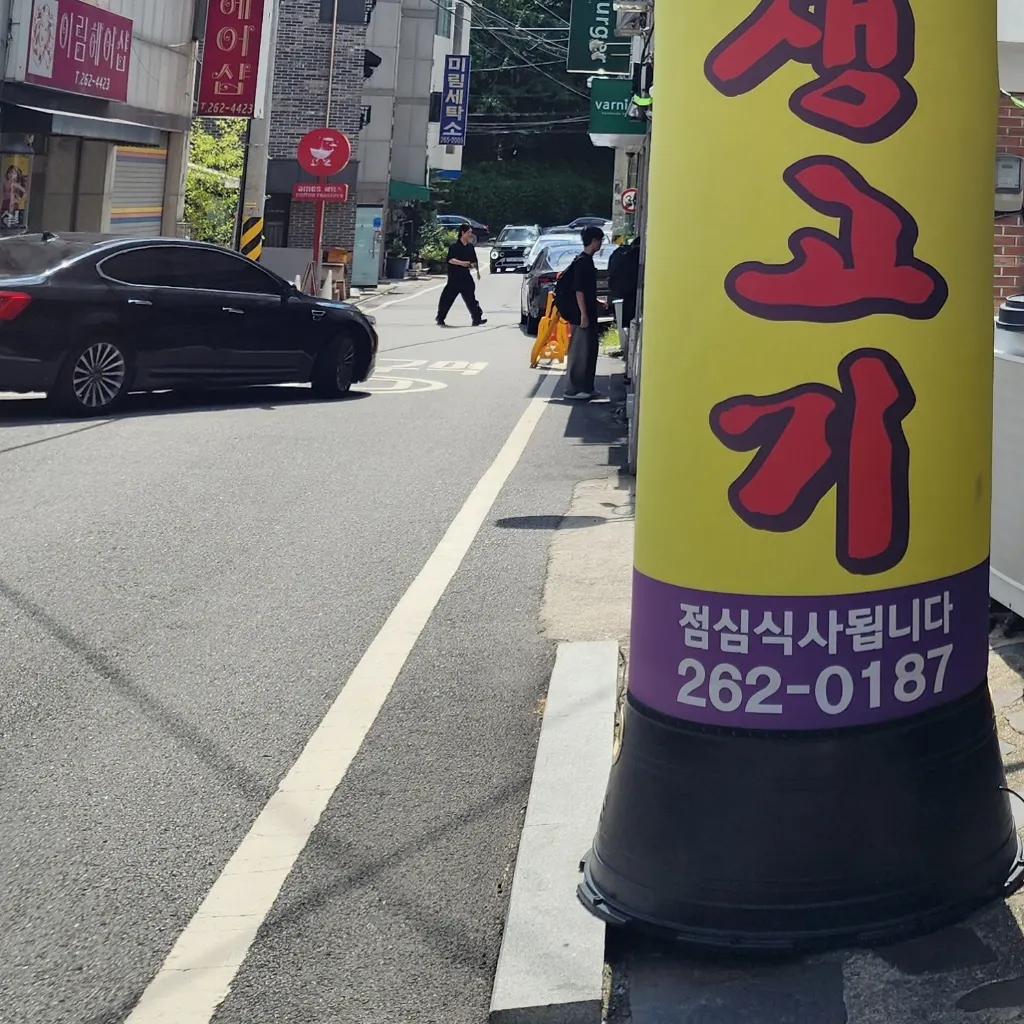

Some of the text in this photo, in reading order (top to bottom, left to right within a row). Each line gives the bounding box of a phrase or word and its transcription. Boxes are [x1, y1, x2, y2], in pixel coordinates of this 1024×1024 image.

[442, 57, 466, 136] 미림세탁소
[594, 98, 629, 111] varni
[678, 590, 954, 655] 점심식사됩니다
[676, 643, 954, 715] 262-0187
